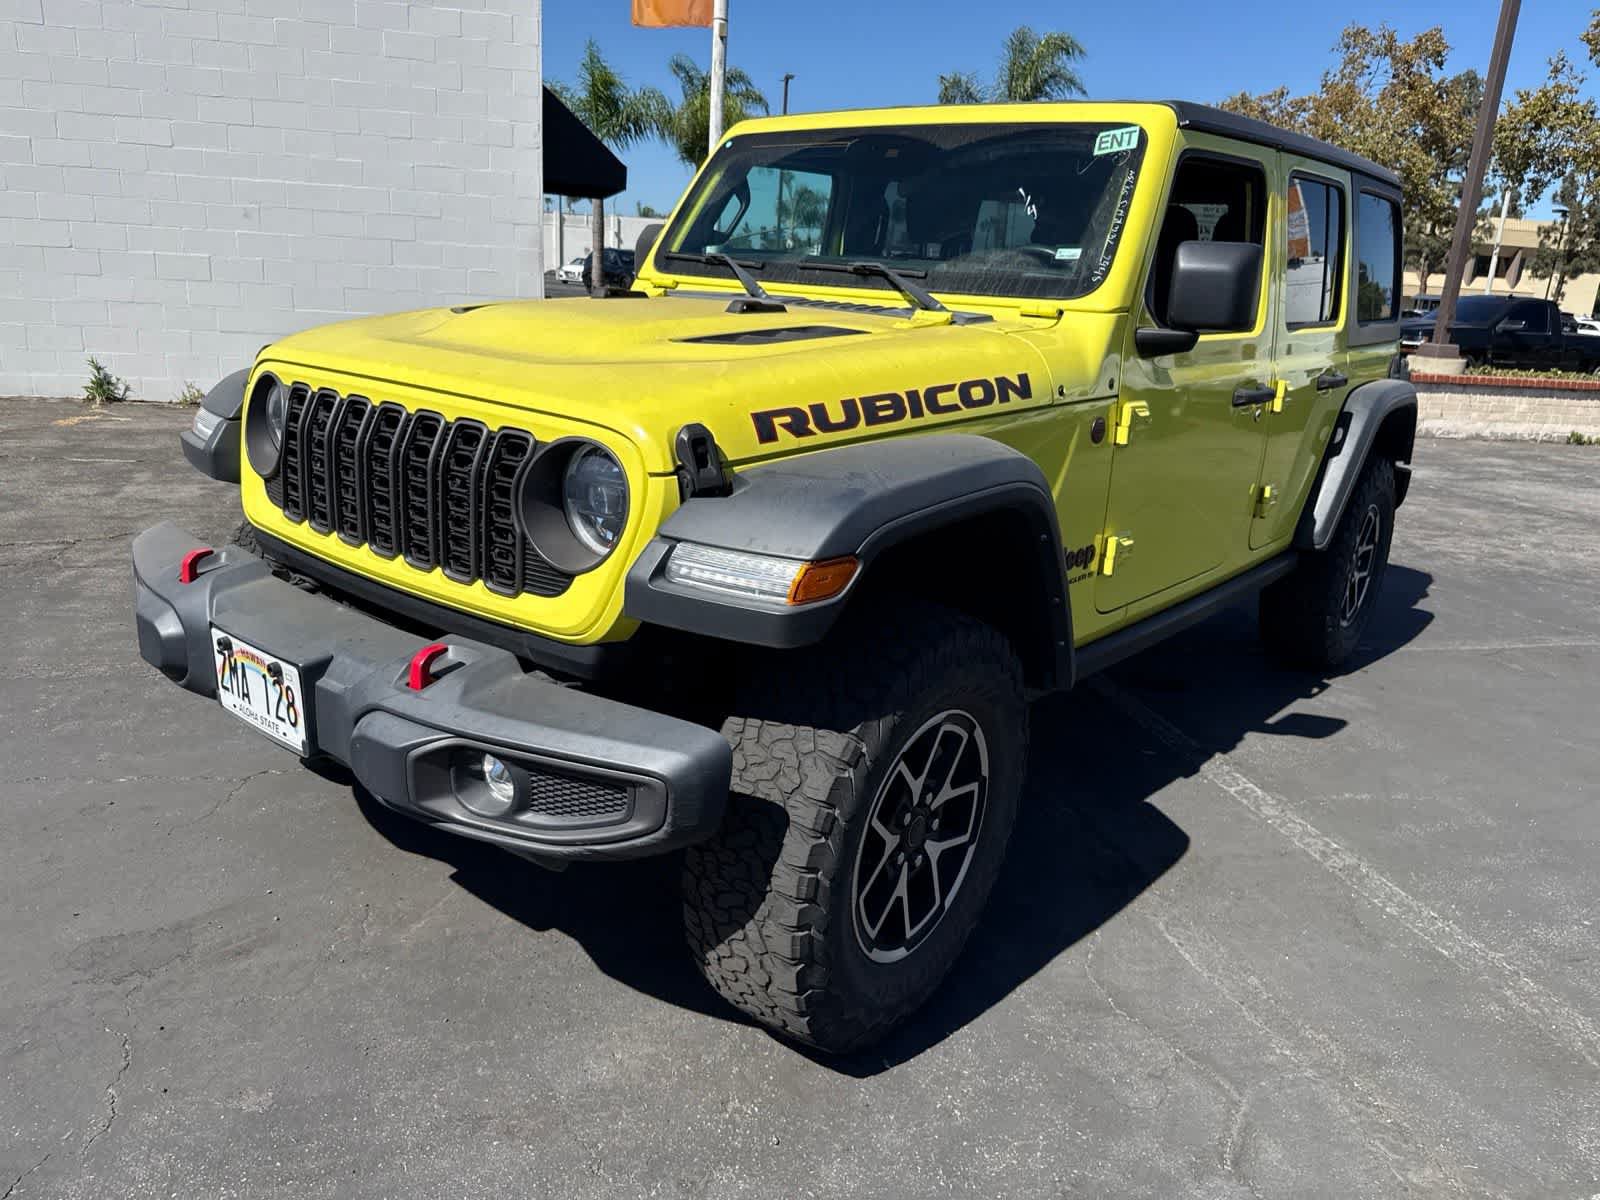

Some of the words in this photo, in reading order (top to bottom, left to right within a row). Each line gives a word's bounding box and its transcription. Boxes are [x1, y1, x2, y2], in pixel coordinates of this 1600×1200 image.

[1099, 130, 1138, 151] ENT
[750, 372, 1033, 445] RUBICON
[216, 648, 251, 705] ZMA
[261, 673, 298, 728] 128
[239, 703, 258, 721] ALOHA
[259, 715, 281, 734] STATE
